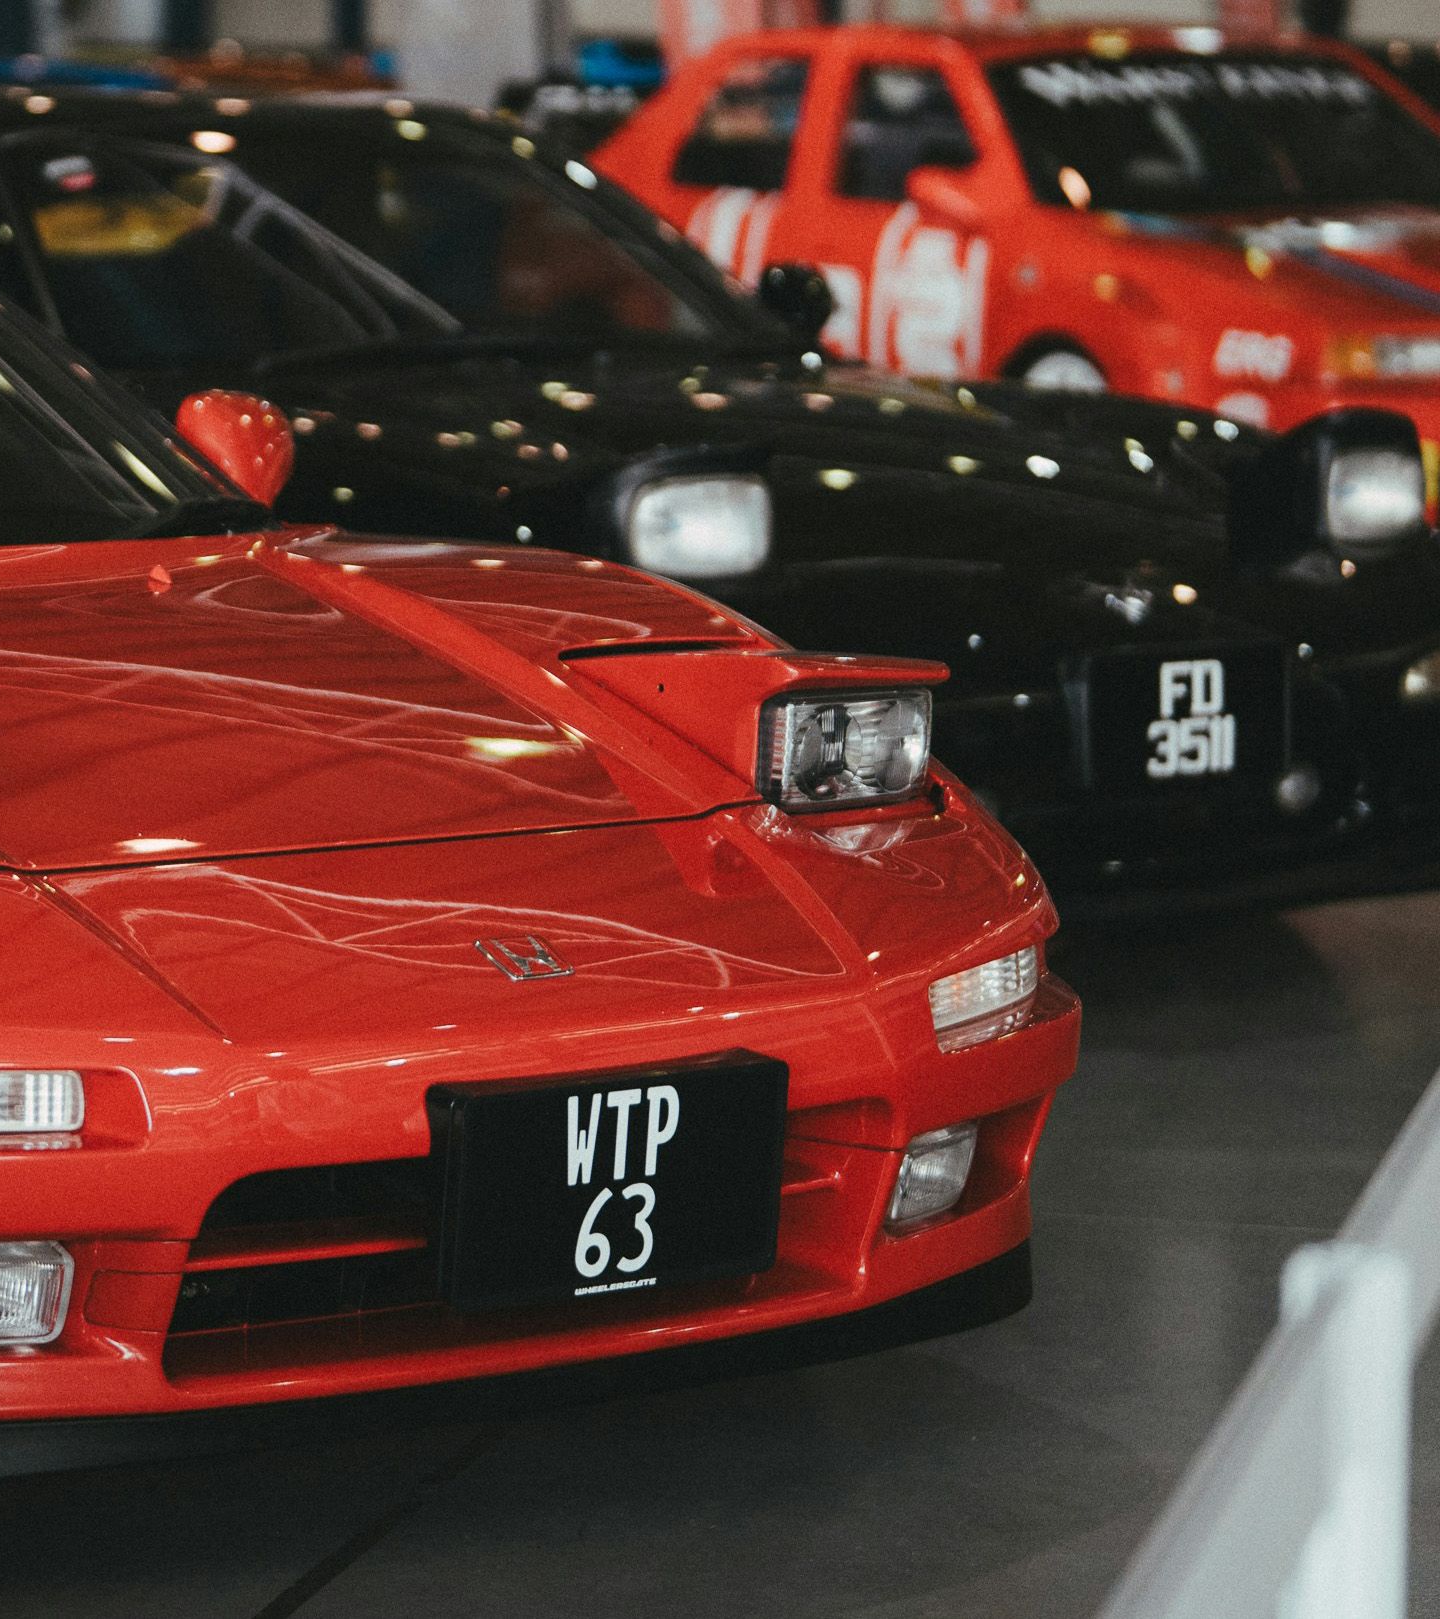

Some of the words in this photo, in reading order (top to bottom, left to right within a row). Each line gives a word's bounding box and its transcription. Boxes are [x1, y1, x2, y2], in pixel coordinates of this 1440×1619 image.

[1160, 659, 1225, 720] FD
[1146, 713, 1236, 778] 3511
[567, 1085, 680, 1186] WTP
[574, 1182, 656, 1278] 63
